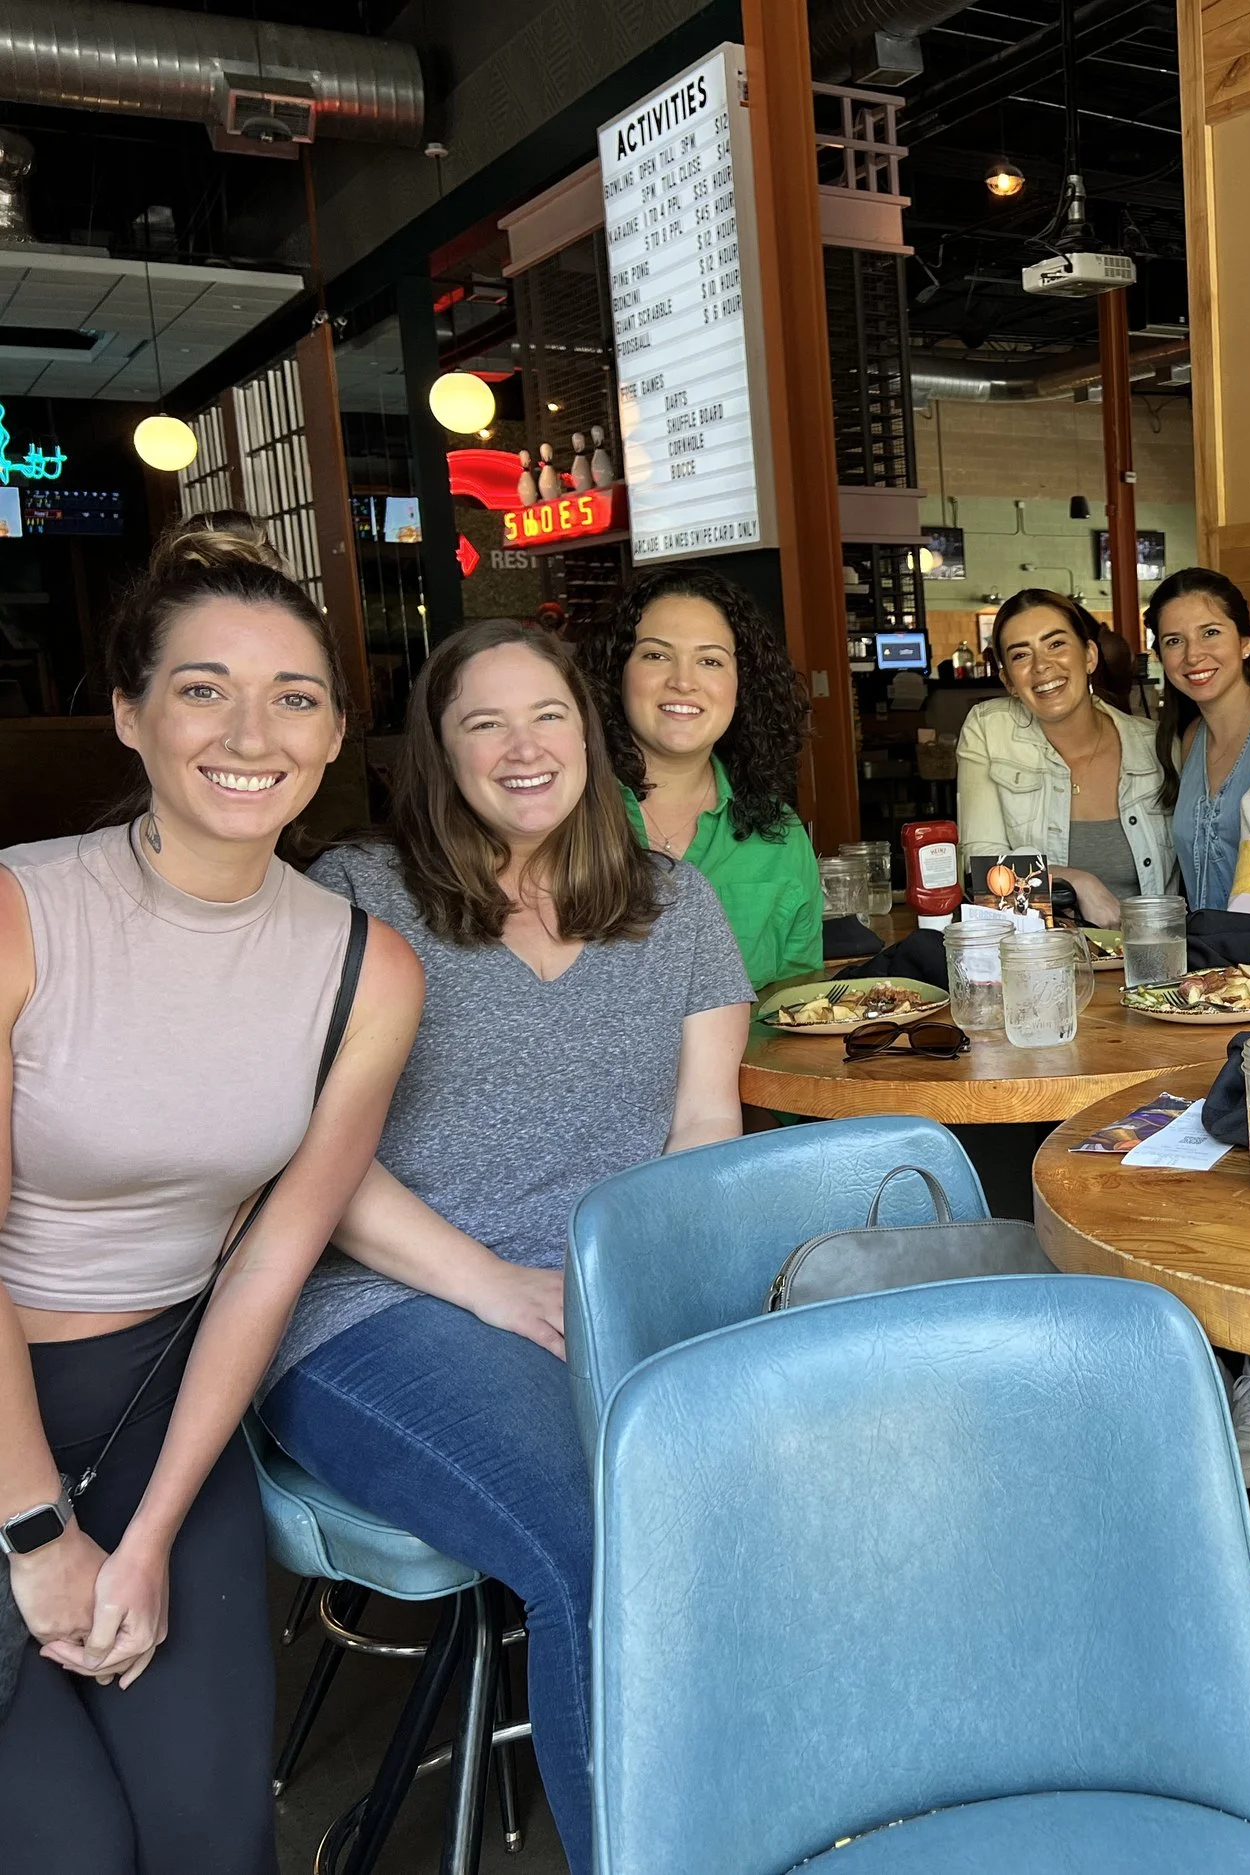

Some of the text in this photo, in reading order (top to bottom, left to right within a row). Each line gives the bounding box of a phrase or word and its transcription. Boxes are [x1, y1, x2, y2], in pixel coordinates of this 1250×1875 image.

[617, 75, 707, 161] ACTIVITIES
[639, 156, 656, 179] OPEN
[678, 156, 701, 182] CLOSE
[612, 269, 629, 290] PING
[631, 259, 649, 281] PONG
[637, 298, 672, 325] SCRABBLE
[641, 373, 664, 394] GAMES
[665, 390, 687, 410] DARTS
[666, 403, 723, 433] SHUFFLE BOARD
[668, 433, 704, 456] CORNHOLE
[670, 460, 695, 478] BOCCE
[633, 537, 659, 554] ARCADE
[738, 519, 757, 537] ONLY
